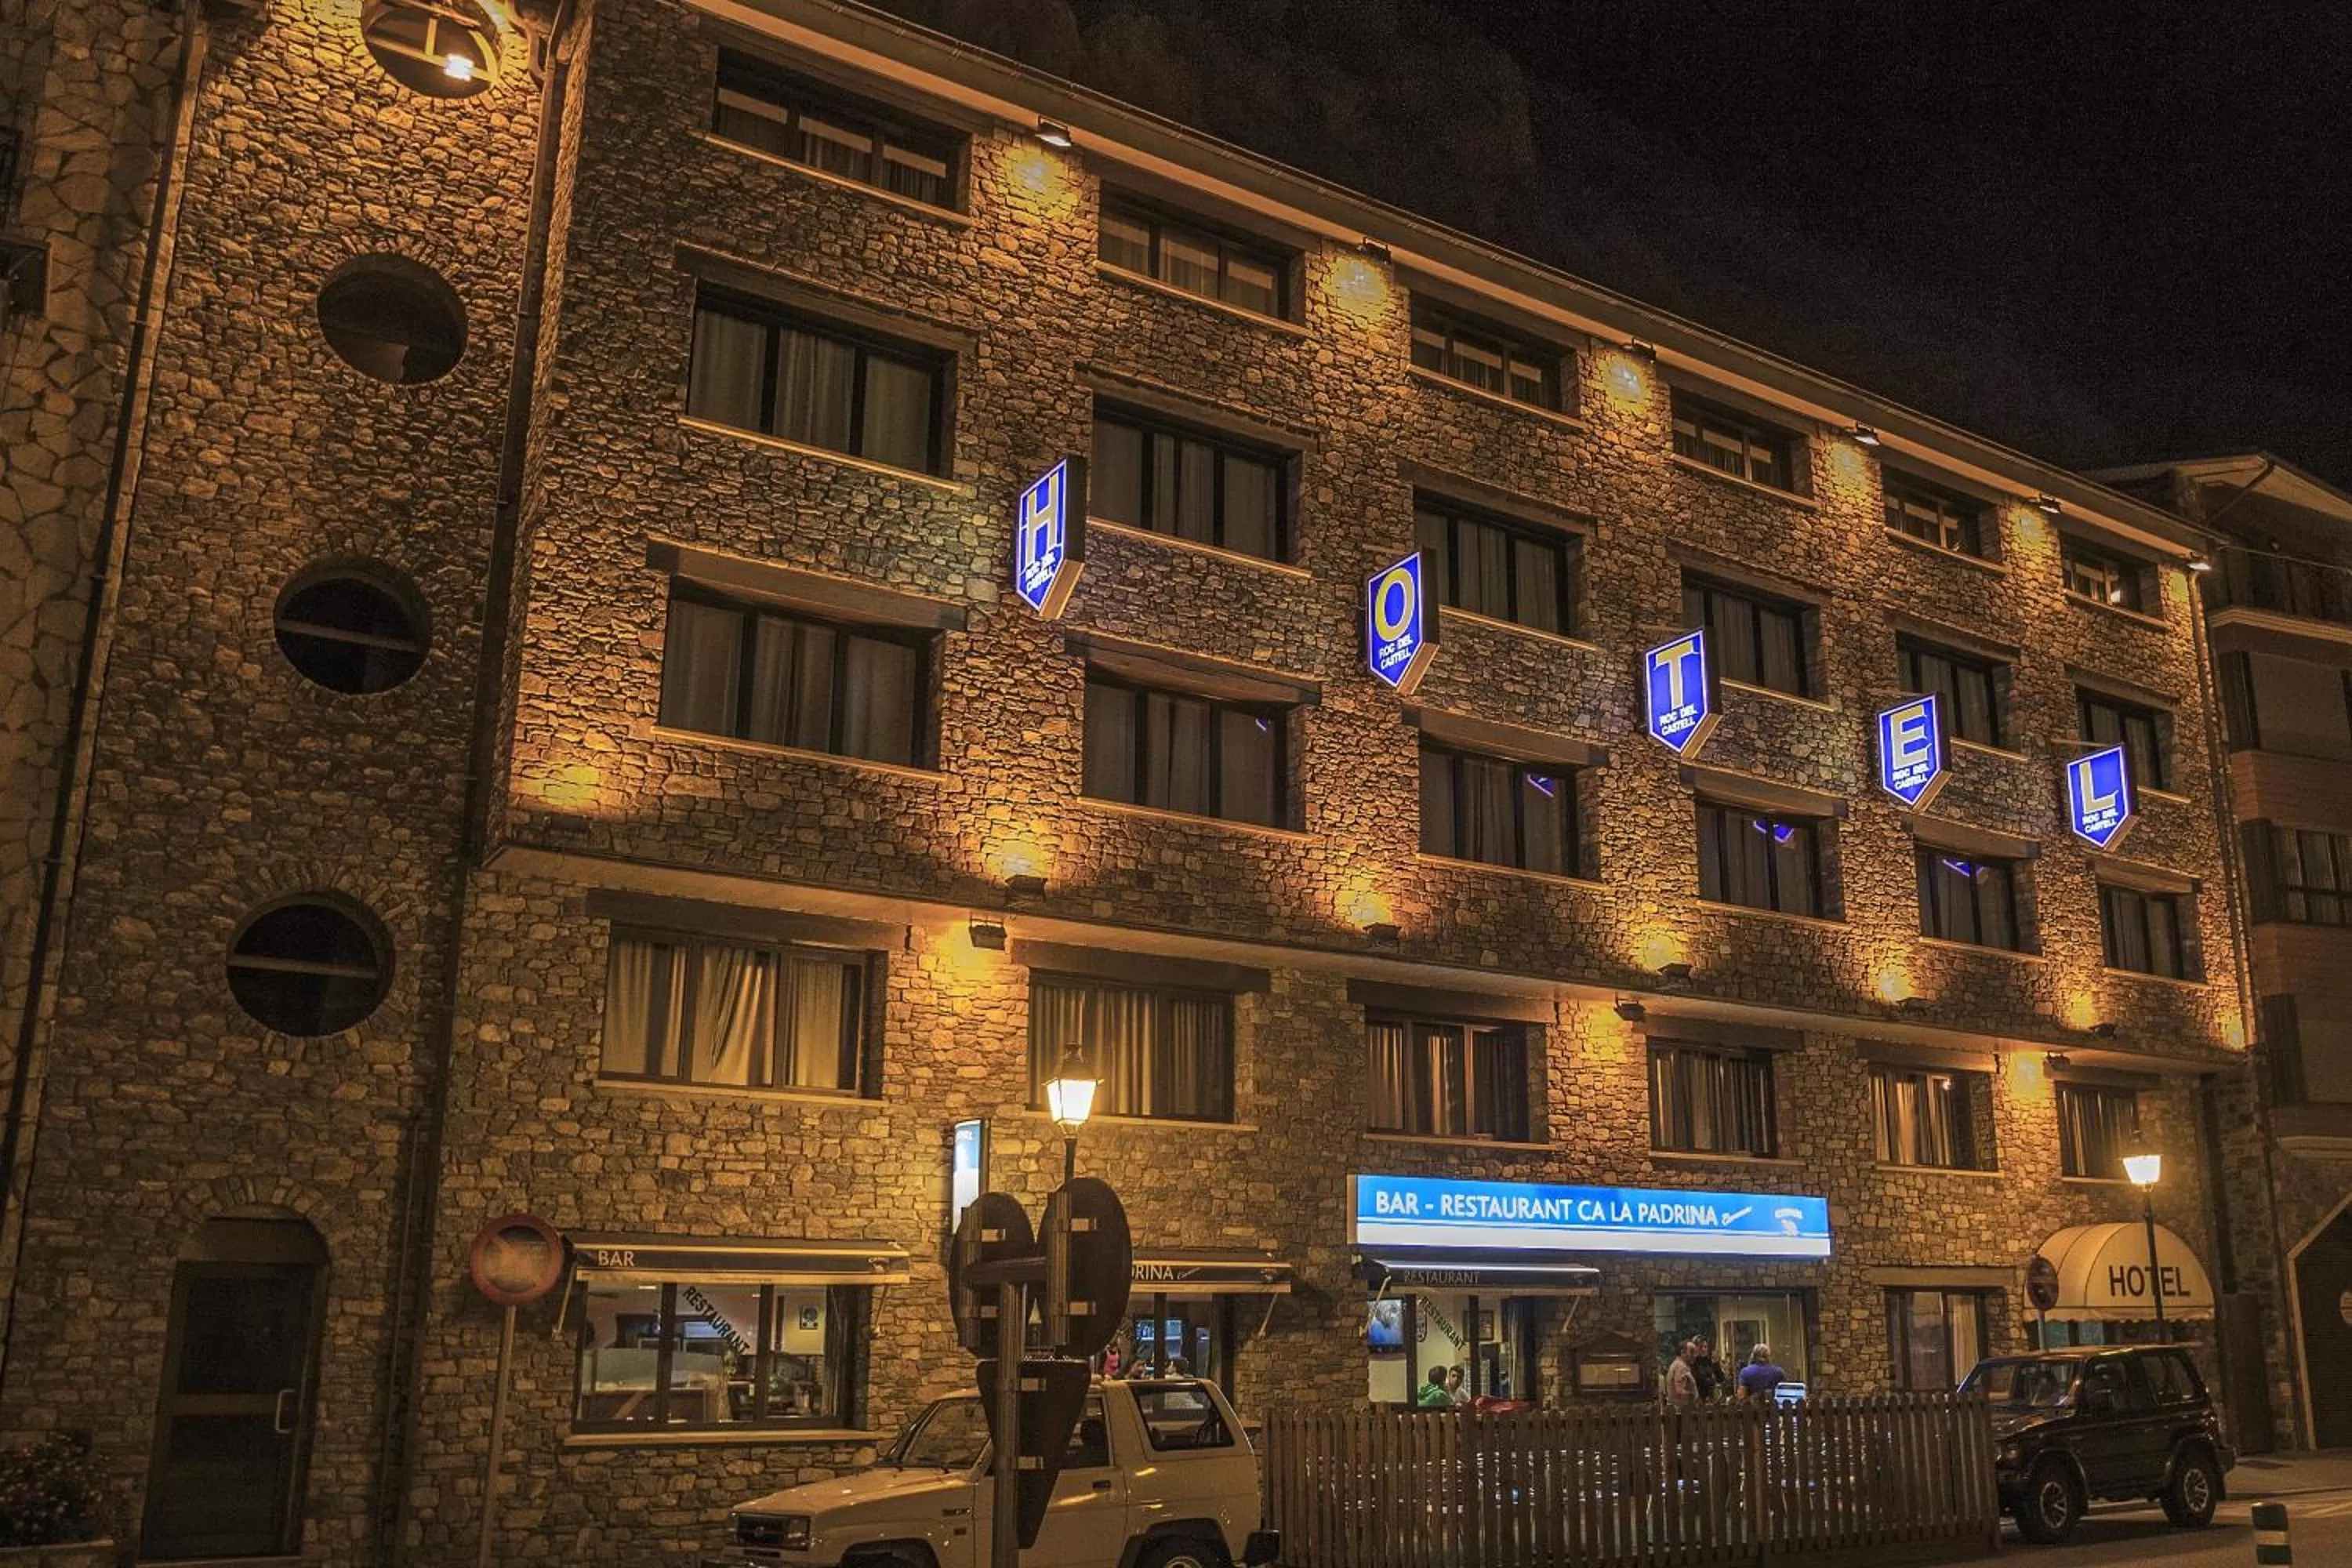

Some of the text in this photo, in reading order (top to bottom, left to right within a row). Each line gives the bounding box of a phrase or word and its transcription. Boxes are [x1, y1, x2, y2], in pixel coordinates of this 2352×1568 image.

[1026, 472, 1058, 567] H
[1374, 567, 1415, 642] O
[1380, 642, 1396, 659] ROC
[1655, 639, 1694, 710] T
[1890, 704, 1929, 770] E
[2079, 761, 2118, 815] L
[1376, 1191, 1419, 1215] BAR
[1440, 1194, 1573, 1221] RESTAURANT
[1577, 1200, 1606, 1222] CA
[1610, 1201, 1633, 1223] LA
[1638, 1203, 1719, 1226] PADRINA
[598, 1250, 634, 1267] BAR
[1404, 1270, 1480, 1284] RESTAURANT
[682, 1287, 750, 1352] RESTAURANT
[1418, 1296, 1467, 1351] RESTAURANT
